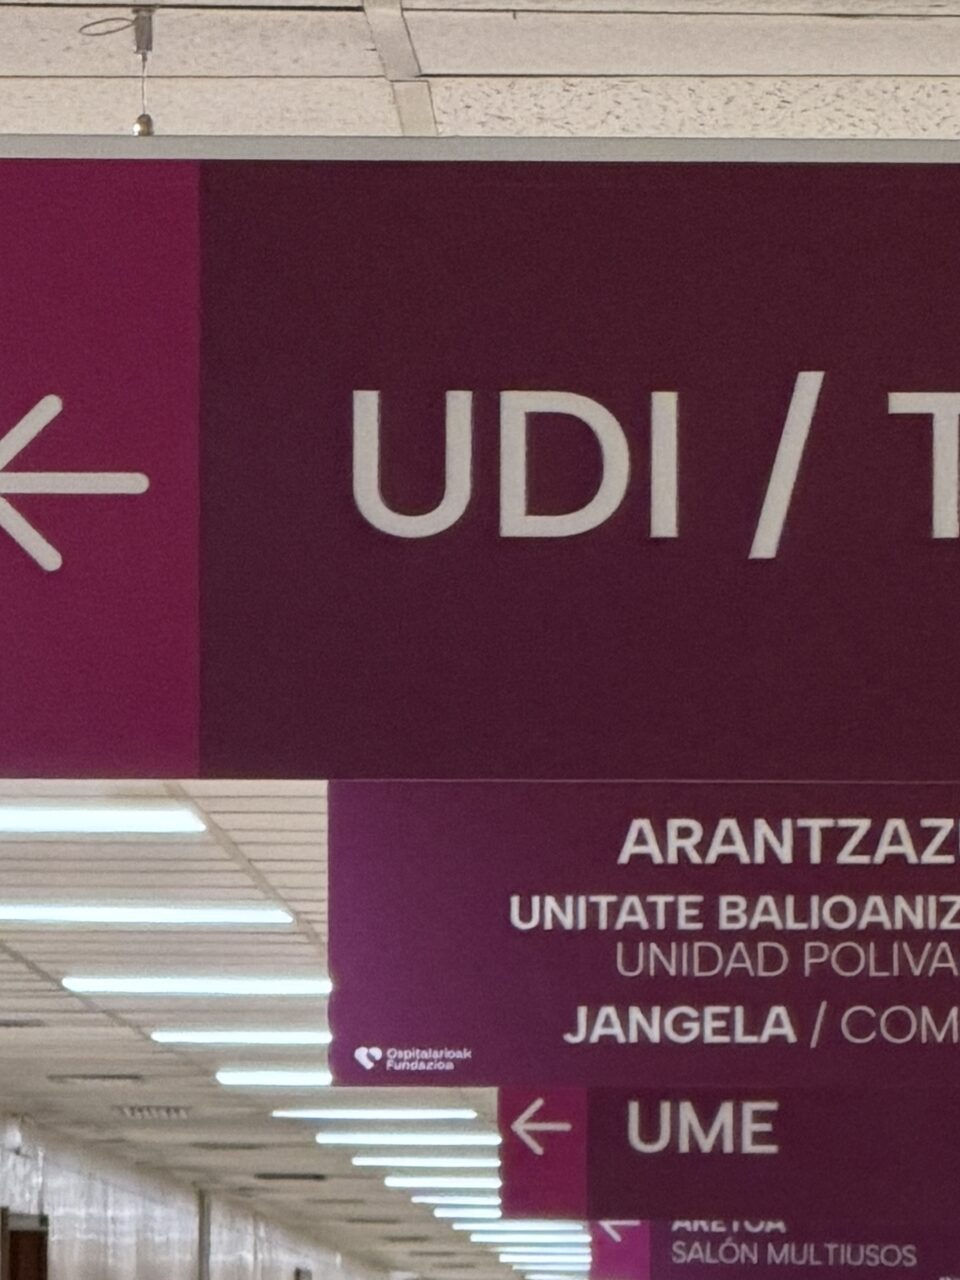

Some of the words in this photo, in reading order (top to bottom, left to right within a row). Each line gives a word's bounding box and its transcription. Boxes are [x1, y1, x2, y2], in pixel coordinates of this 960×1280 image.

[352, 389, 679, 539] UDI
[749, 370, 825, 559] /
[510, 894, 704, 931] UNITATE
[616, 941, 789, 977] UNIDAD
[563, 1005, 797, 1044] JANGELA
[810, 1000, 828, 1049] /
[386, 1047, 472, 1061] Ospitalarioak
[386, 1060, 455, 1071] Fundazioa
[627, 1100, 779, 1154] UME
[671, 1237, 758, 1265] SALÓN
[767, 1242, 918, 1267] MULTIUSOS
